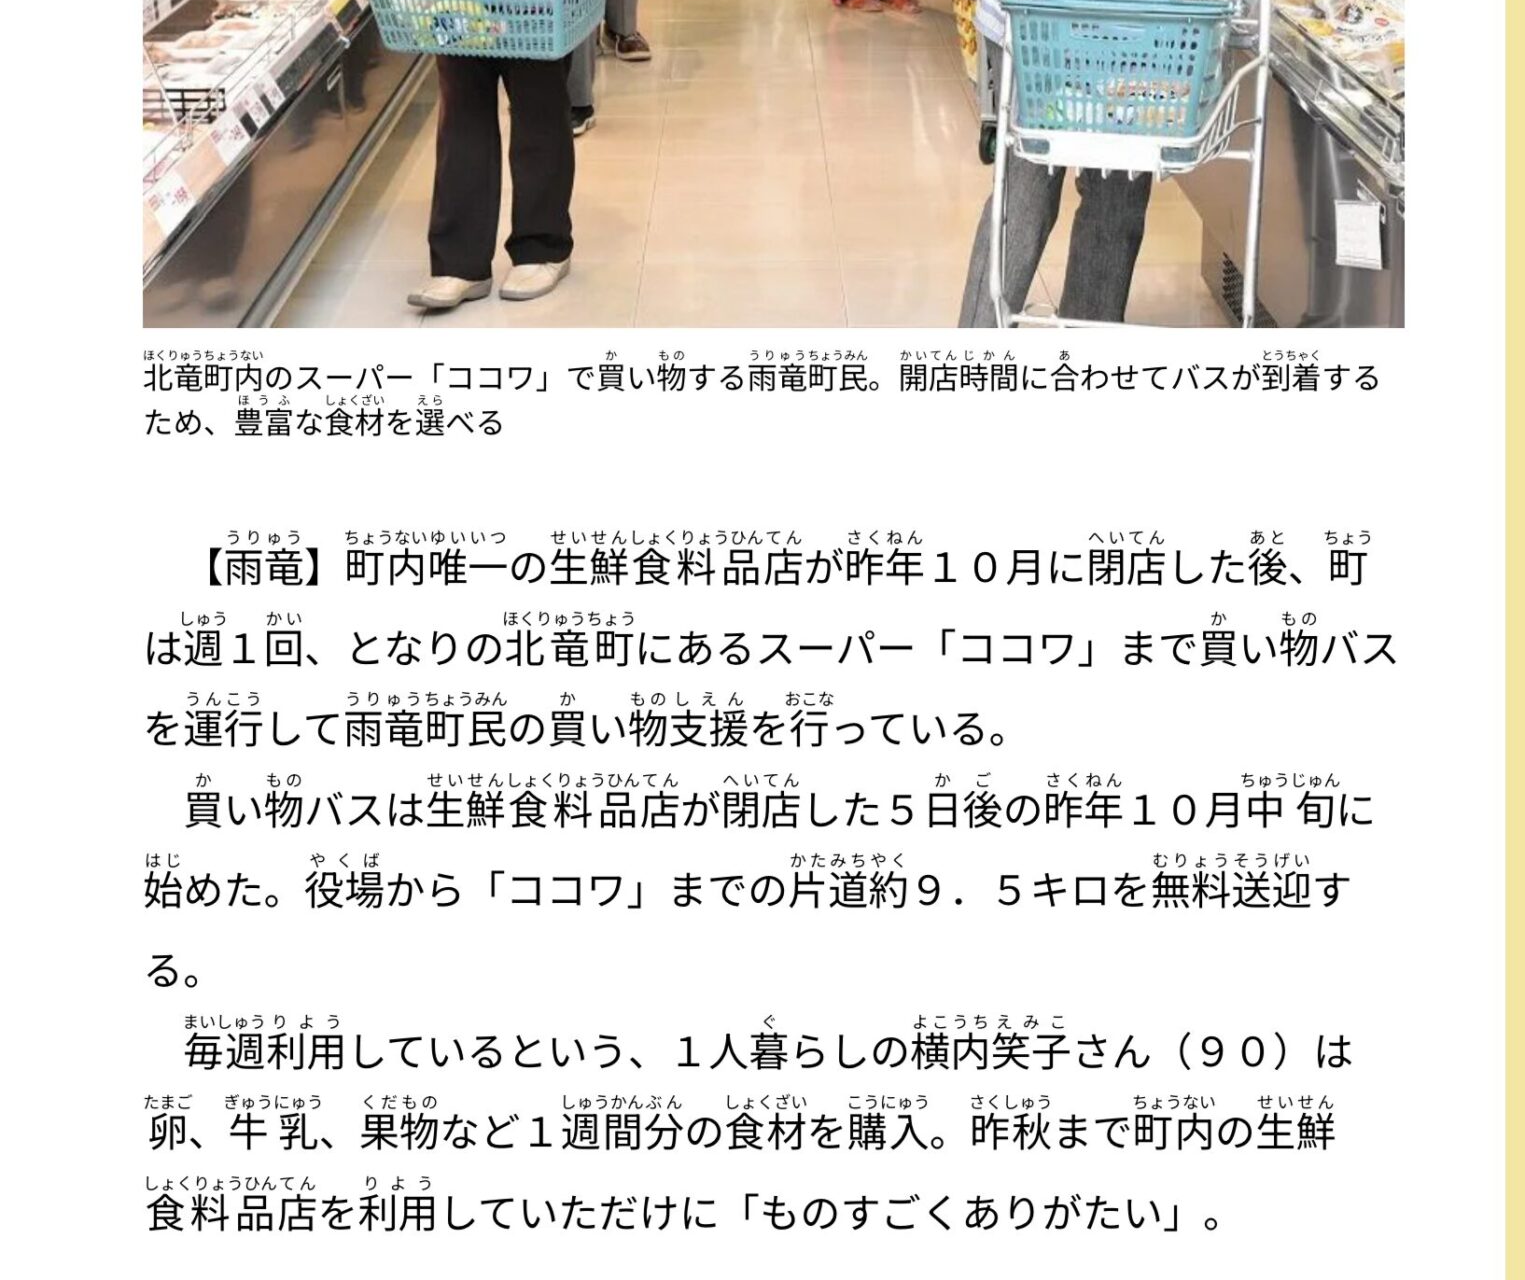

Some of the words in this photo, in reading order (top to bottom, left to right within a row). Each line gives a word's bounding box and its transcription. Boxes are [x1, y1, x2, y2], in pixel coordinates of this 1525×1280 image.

[144, 350, 263, 361] ほくりゅうちょうない
[606, 351, 617, 360] か
[659, 351, 684, 361] もの
[751, 350, 867, 361] うりゅうちょうみん
[901, 350, 1015, 361] かいてんじかん
[1060, 350, 1070, 360] あ
[1263, 350, 1318, 361] とうちゃく
[144, 363, 1378, 392] 北竜町内のスーパー「ココワ」で買い物する雨竜町民。開店時間に合わせてバスが到着する
[239, 395, 289, 405] ほうふ
[327, 395, 384, 406] しょくざい
[418, 395, 442, 405] えら
[145, 408, 501, 436] ため、豊富な食材を選べる
[227, 530, 300, 545] うりゅう
[345, 530, 505, 545] ちょうないゆいいつ
[551, 530, 801, 545] せいせんしょくりょうひんてん
[848, 530, 922, 545] さくねん
[1089, 531, 1164, 545] へいてん
[1251, 530, 1283, 545] あと
[1325, 530, 1370, 545] ちょう
[210, 547, 1367, 586] 【雨竜】町内唯一の生鮮食料品店が昨年１０月に閉店した後、町
[182, 612, 225, 626] しゅう
[267, 612, 301, 626] かい
[504, 611, 633, 626] ほくりゅうちょう
[1211, 612, 1226, 625] か
[1282, 612, 1316, 626] もの
[147, 629, 1396, 667] は週１回、となりの北竜町にあるスーパー「ココワ」まで買い物バス
[187, 692, 259, 706] うんこう
[348, 692, 507, 706] うりゅうちょうみん
[560, 692, 575, 706] か
[631, 692, 743, 706] ものしえん
[786, 692, 833, 706] おこな
[147, 709, 1003, 747] を運行して雨竜町民の買い物支援を行っている。
[196, 773, 211, 787] か
[267, 773, 301, 787] もの
[427, 773, 678, 788] せいせんしょくりょうひんてん
[724, 773, 799, 787] へいてん
[935, 773, 950, 787] か
[977, 772, 990, 787] ご
[1047, 773, 1121, 787] さくねん
[1241, 773, 1339, 788] ちゅうじゅん
[186, 790, 1372, 828] 買い物バスは生鮮食料品店が閉店した５日後の昨年１０月中旬に
[146, 853, 179, 868] はじ
[310, 853, 379, 868] やくば
[791, 853, 902, 868] かたみちやく
[1154, 853, 1309, 868] むりょうそうげい
[148, 955, 197, 988] る。
[185, 1015, 339, 1029] まいしゅうりよう
[764, 1015, 775, 1029] ぐ
[914, 1015, 1064, 1029] よこうちえみこ
[185, 1032, 1351, 1070] 毎週利用しているという、１人暮らしの横内笑子さん（９０）は
[144, 1095, 192, 1109] たまご
[226, 1094, 320, 1110] ぎゅうにゅう
[364, 1095, 437, 1109] くだもの
[564, 1095, 681, 1109] しゅうかんぶん
[727, 1094, 806, 1109] しょくざい
[849, 1095, 927, 1109] こうにゅう
[971, 1095, 1050, 1109] さくしゅう
[1134, 1095, 1215, 1109] ちょうない
[1258, 1095, 1333, 1109] せいせん
[149, 1112, 1335, 1150] 卵、牛乳、果物など１週間分の食材を購入。昨秋まで町内の生鮮
[147, 1176, 315, 1191] しょくりょうひんてん
[366, 1176, 430, 1191] りよう
[147, 1193, 1217, 1232] 食料品店を利用していただけに「ものすごくありがたい」。
